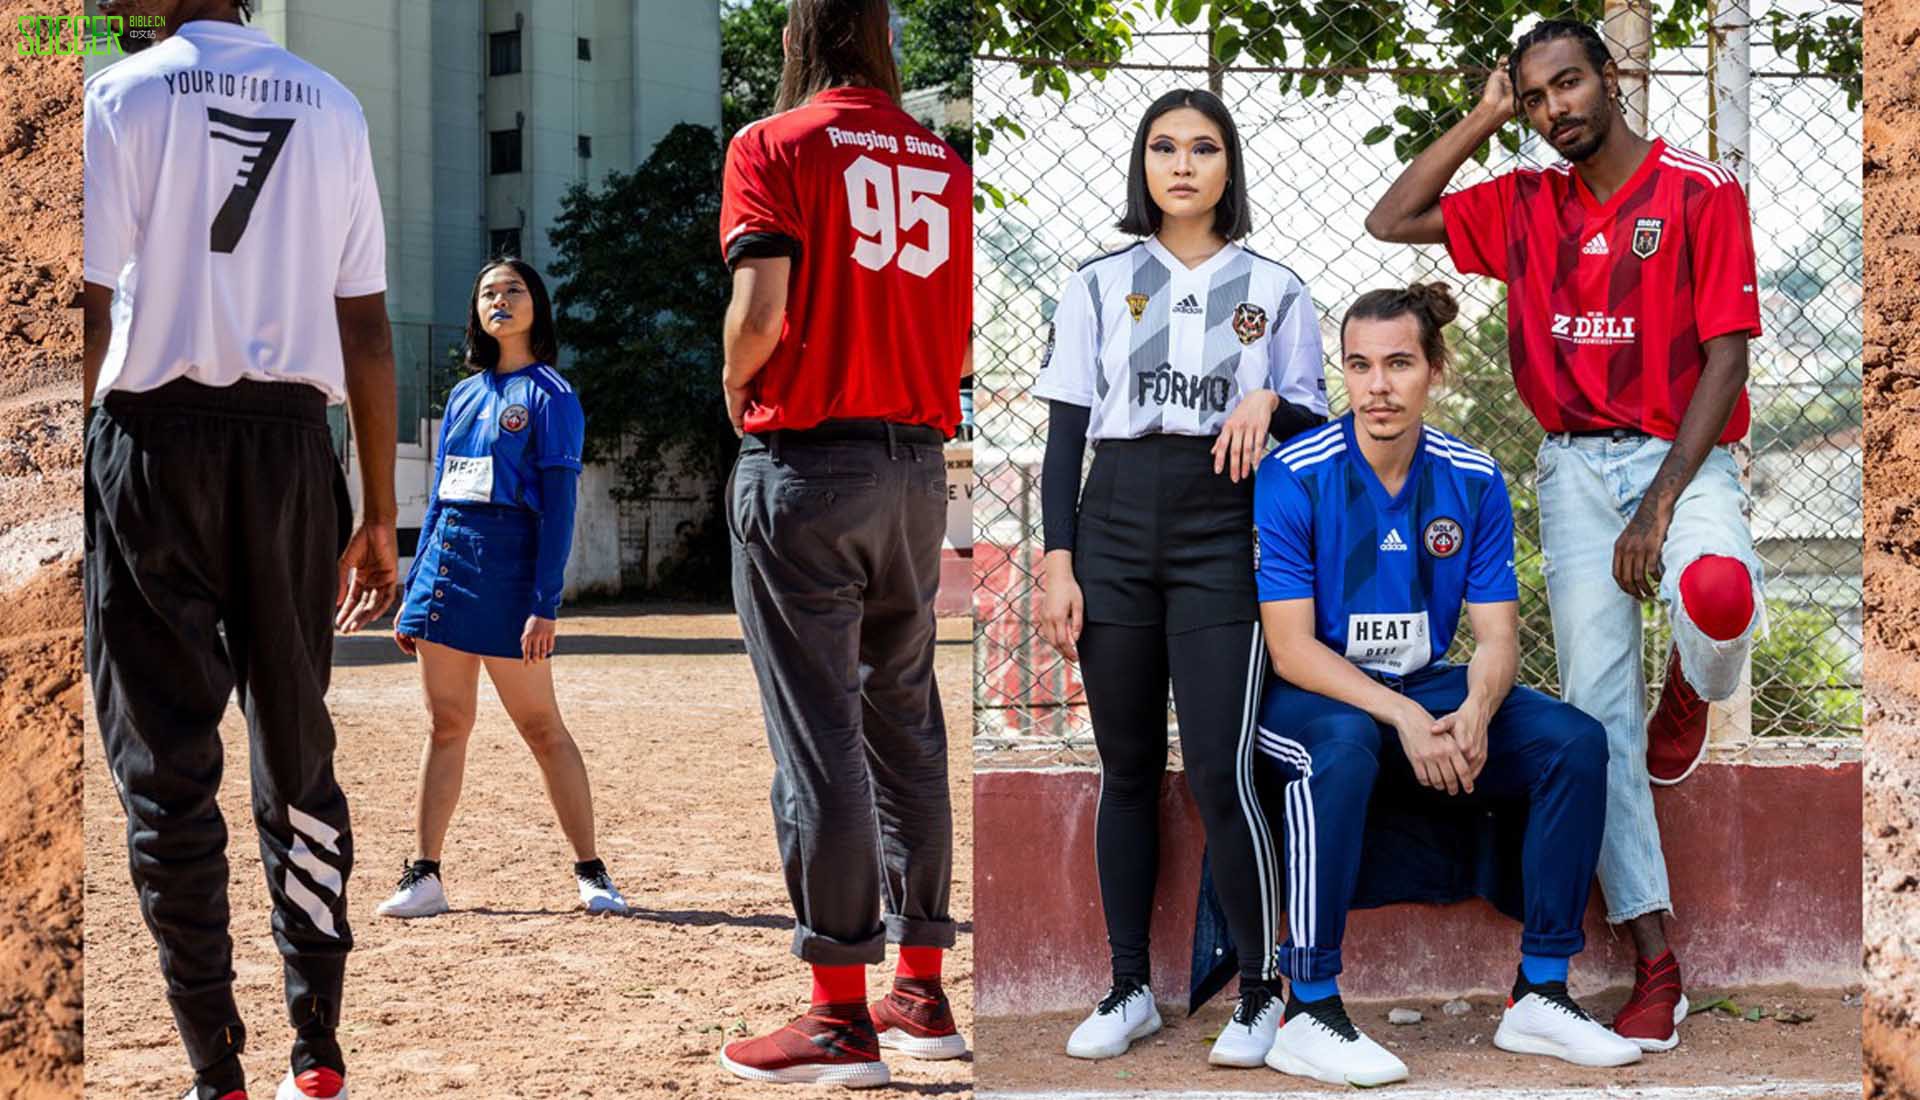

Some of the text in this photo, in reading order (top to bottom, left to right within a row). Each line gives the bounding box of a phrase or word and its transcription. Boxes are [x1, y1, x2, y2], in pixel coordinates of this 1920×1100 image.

[164, 70, 215, 95] YOUR
[240, 75, 322, 109] FOOTBALL
[825, 126, 947, 160] Amazing Since
[207, 106, 297, 255] 7
[843, 154, 951, 279] 95
[1551, 313, 1635, 338] Z DELI
[1356, 620, 1411, 641] HEAT
